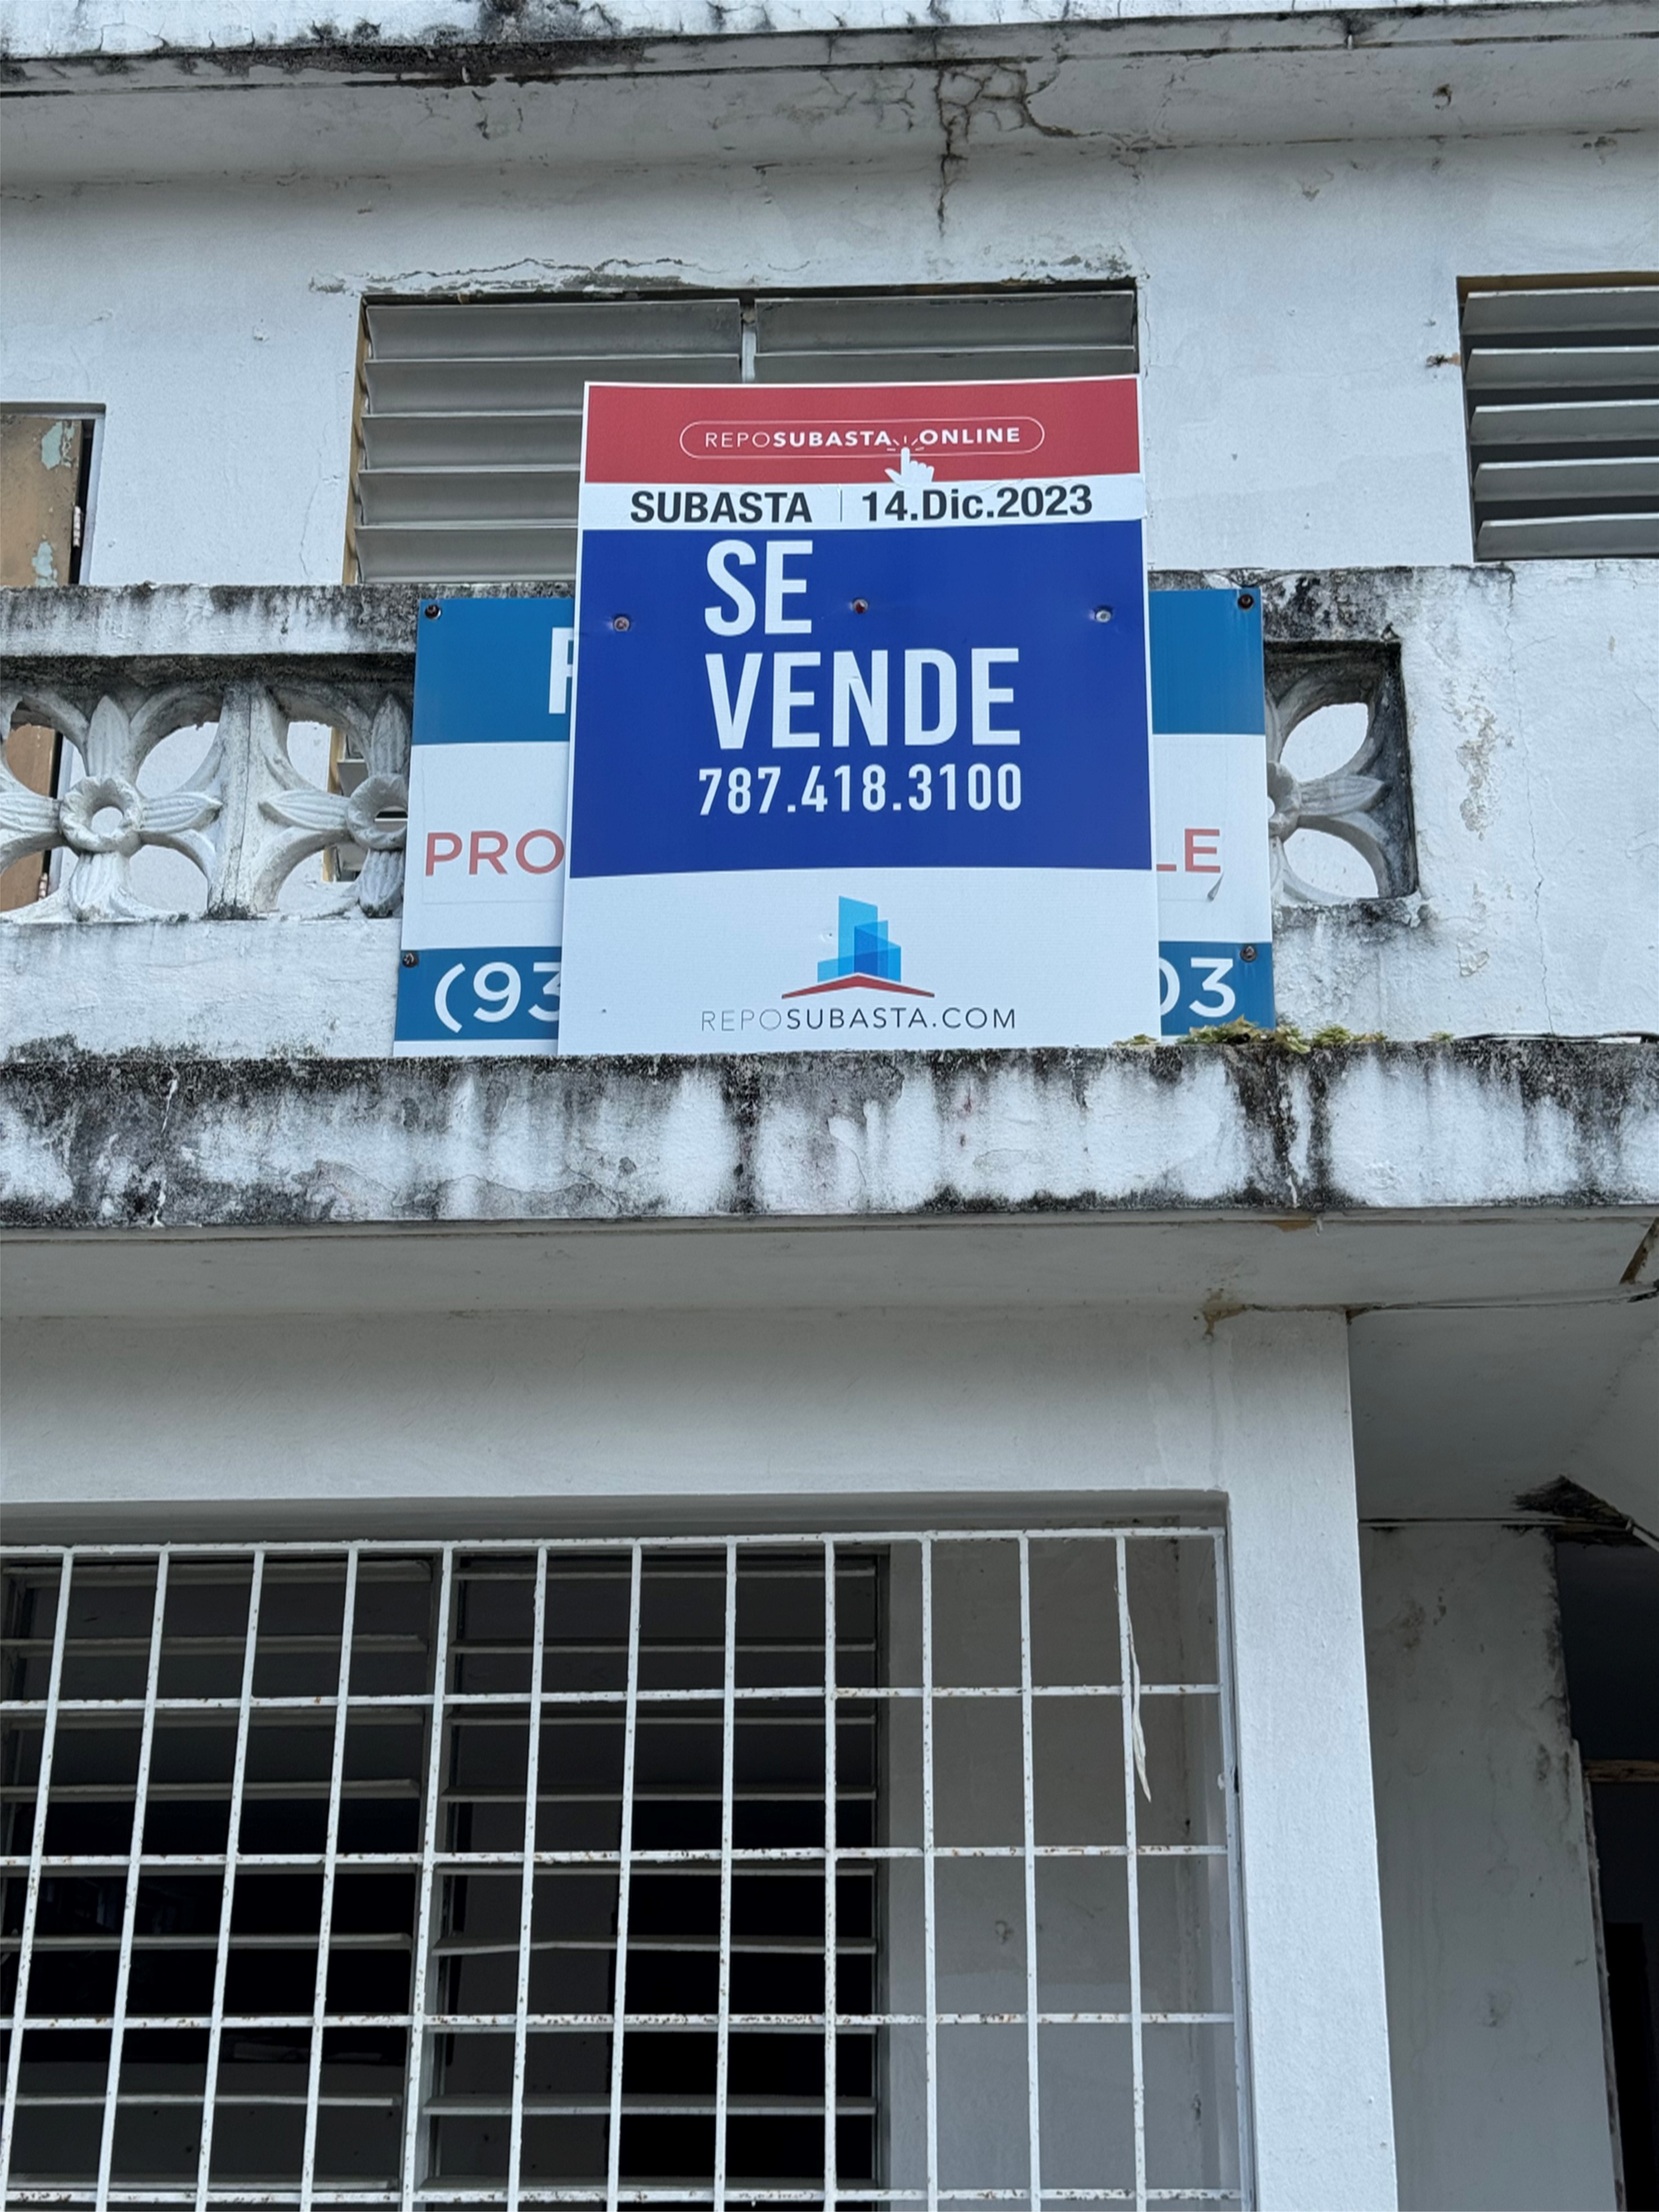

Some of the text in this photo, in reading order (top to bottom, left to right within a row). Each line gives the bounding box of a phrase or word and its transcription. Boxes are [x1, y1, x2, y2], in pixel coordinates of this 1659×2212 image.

[704, 427, 1020, 448] REPOSUBASTA ONLINE
[630, 484, 1093, 523] SUBASTA 14.Dic.2023
[704, 539, 813, 636] SE
[705, 648, 1021, 750] VENDE
[699, 763, 1022, 815] 787.418.3100
[701, 1006, 1015, 1032] REPOSUBASTA.COM
